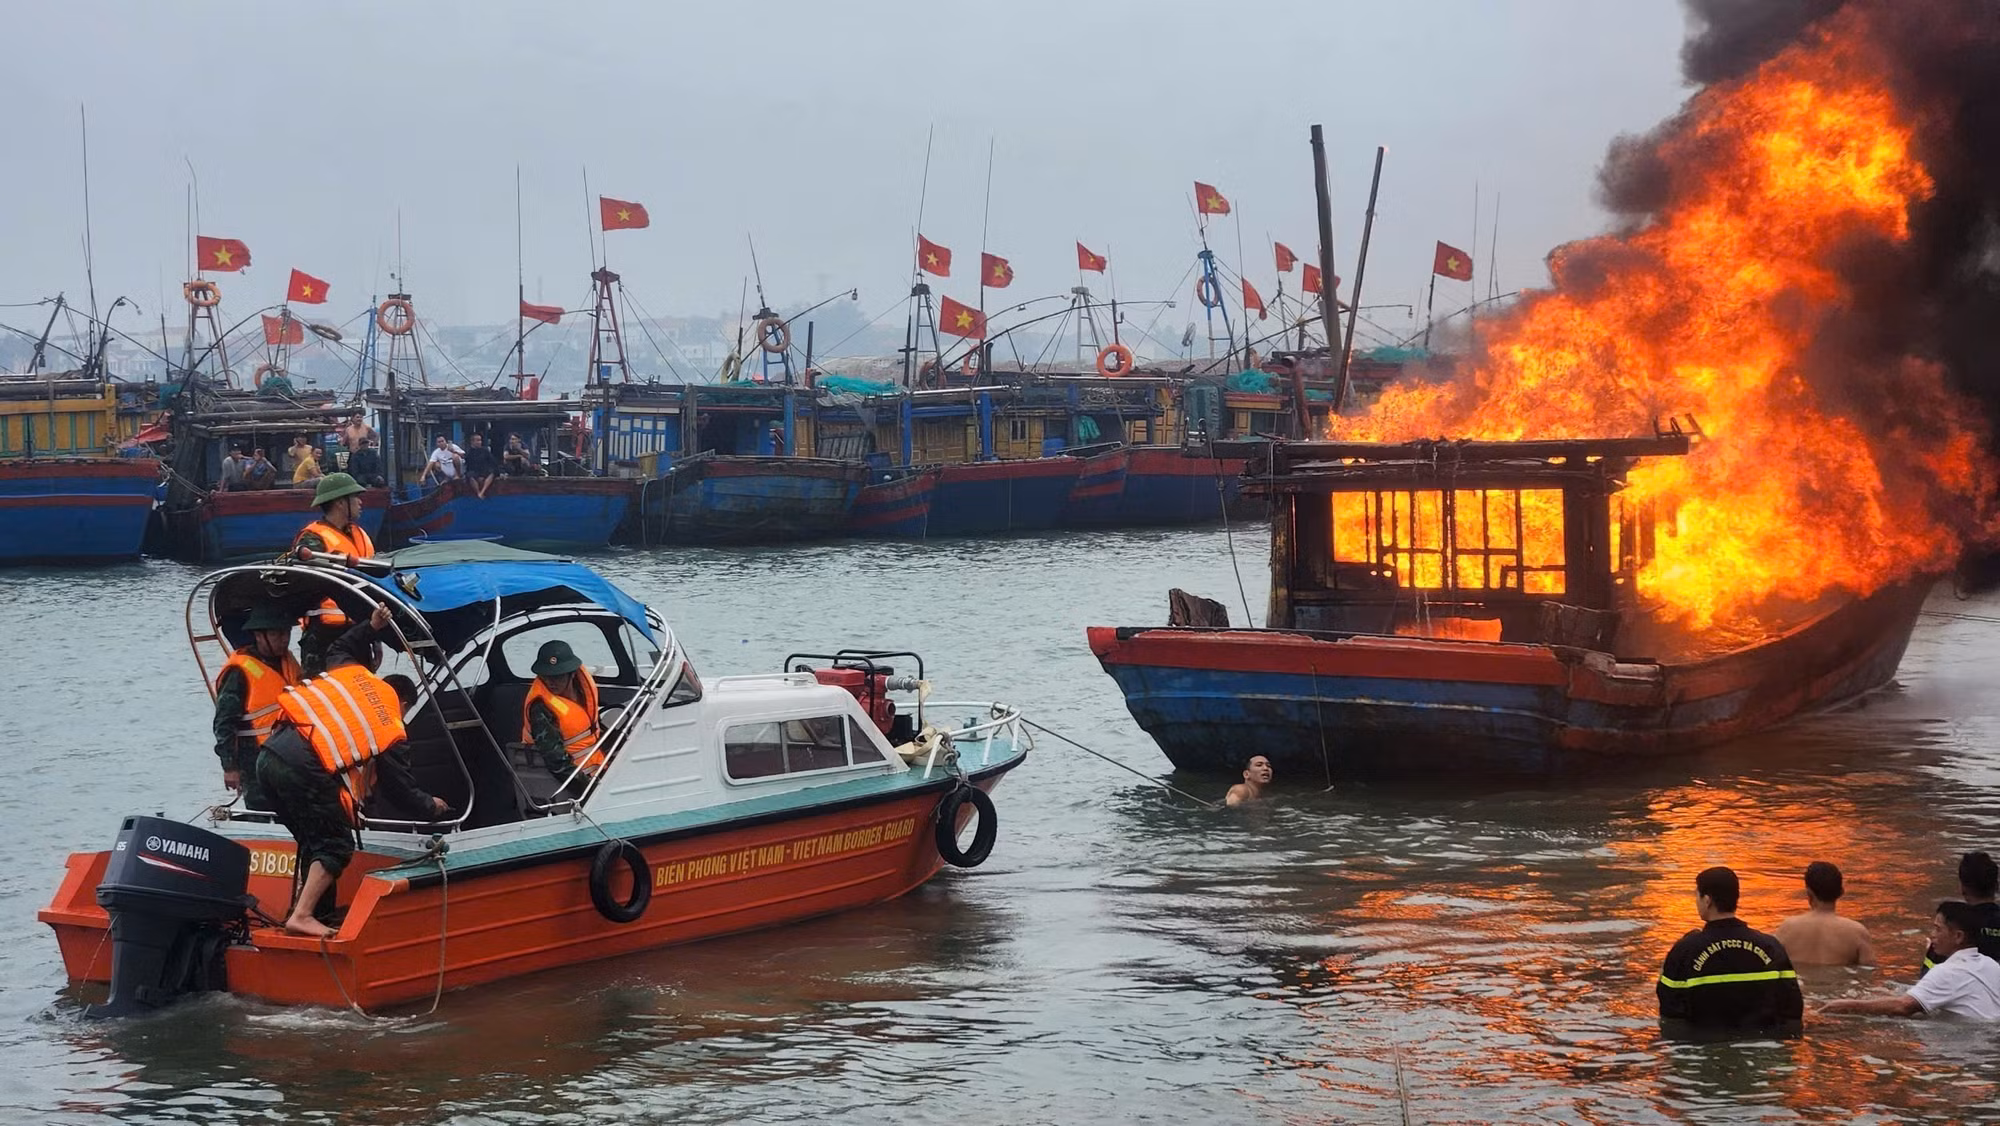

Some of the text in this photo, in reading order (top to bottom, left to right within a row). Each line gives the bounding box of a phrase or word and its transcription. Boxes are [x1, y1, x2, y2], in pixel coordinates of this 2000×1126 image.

[161, 839, 210, 862] YAMAHA
[758, 844, 785, 867] NAM
[844, 826, 882, 851] BORDER
[884, 818, 915, 841] GUARD
[1721, 939, 1742, 949] PCCC
